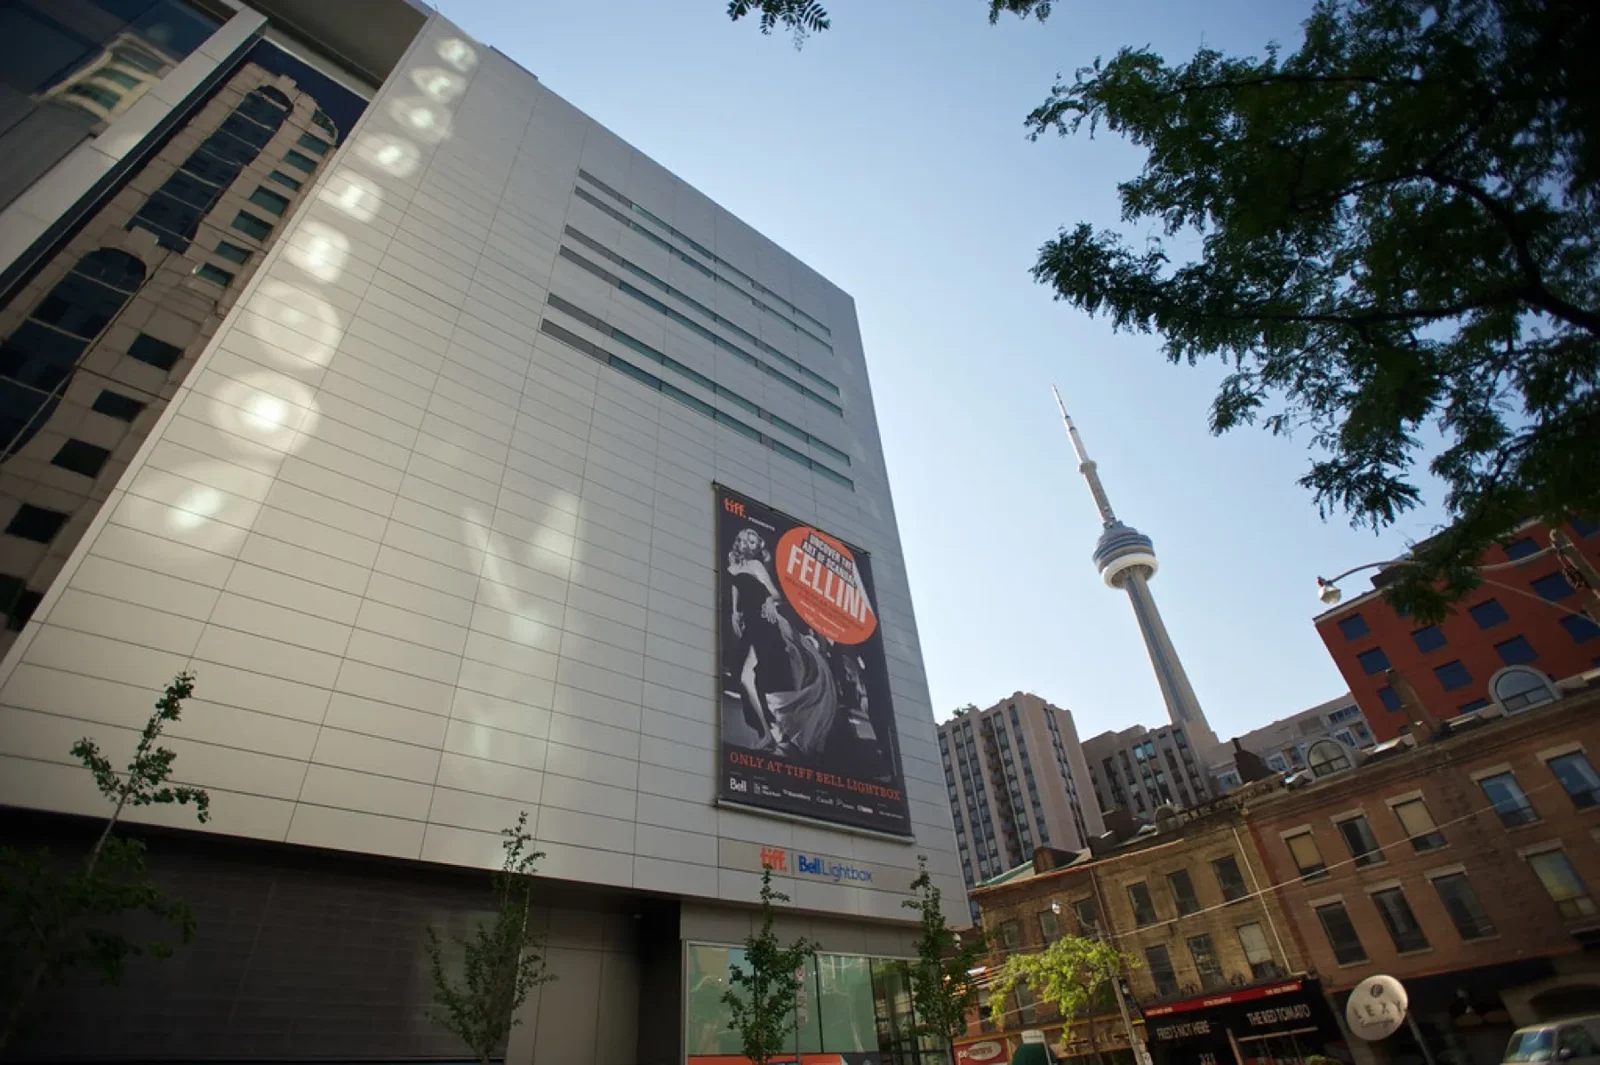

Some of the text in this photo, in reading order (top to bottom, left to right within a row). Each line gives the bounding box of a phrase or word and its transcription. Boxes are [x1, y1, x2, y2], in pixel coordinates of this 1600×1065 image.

[786, 544, 867, 623] FELLINI
[730, 751, 764, 769] ONLY
[767, 760, 783, 774] AT
[785, 764, 813, 780] TIFF
[816, 771, 845, 788] BELL
[847, 779, 901, 801] LIGHTBOX
[730, 777, 747, 792] Bell
[798, 855, 873, 882] Bell Lightbox
[1246, 1004, 1311, 1026] THE RED TOMATO
[1352, 1000, 1403, 1019] LEXY
[1193, 1020, 1211, 1035] HERE
